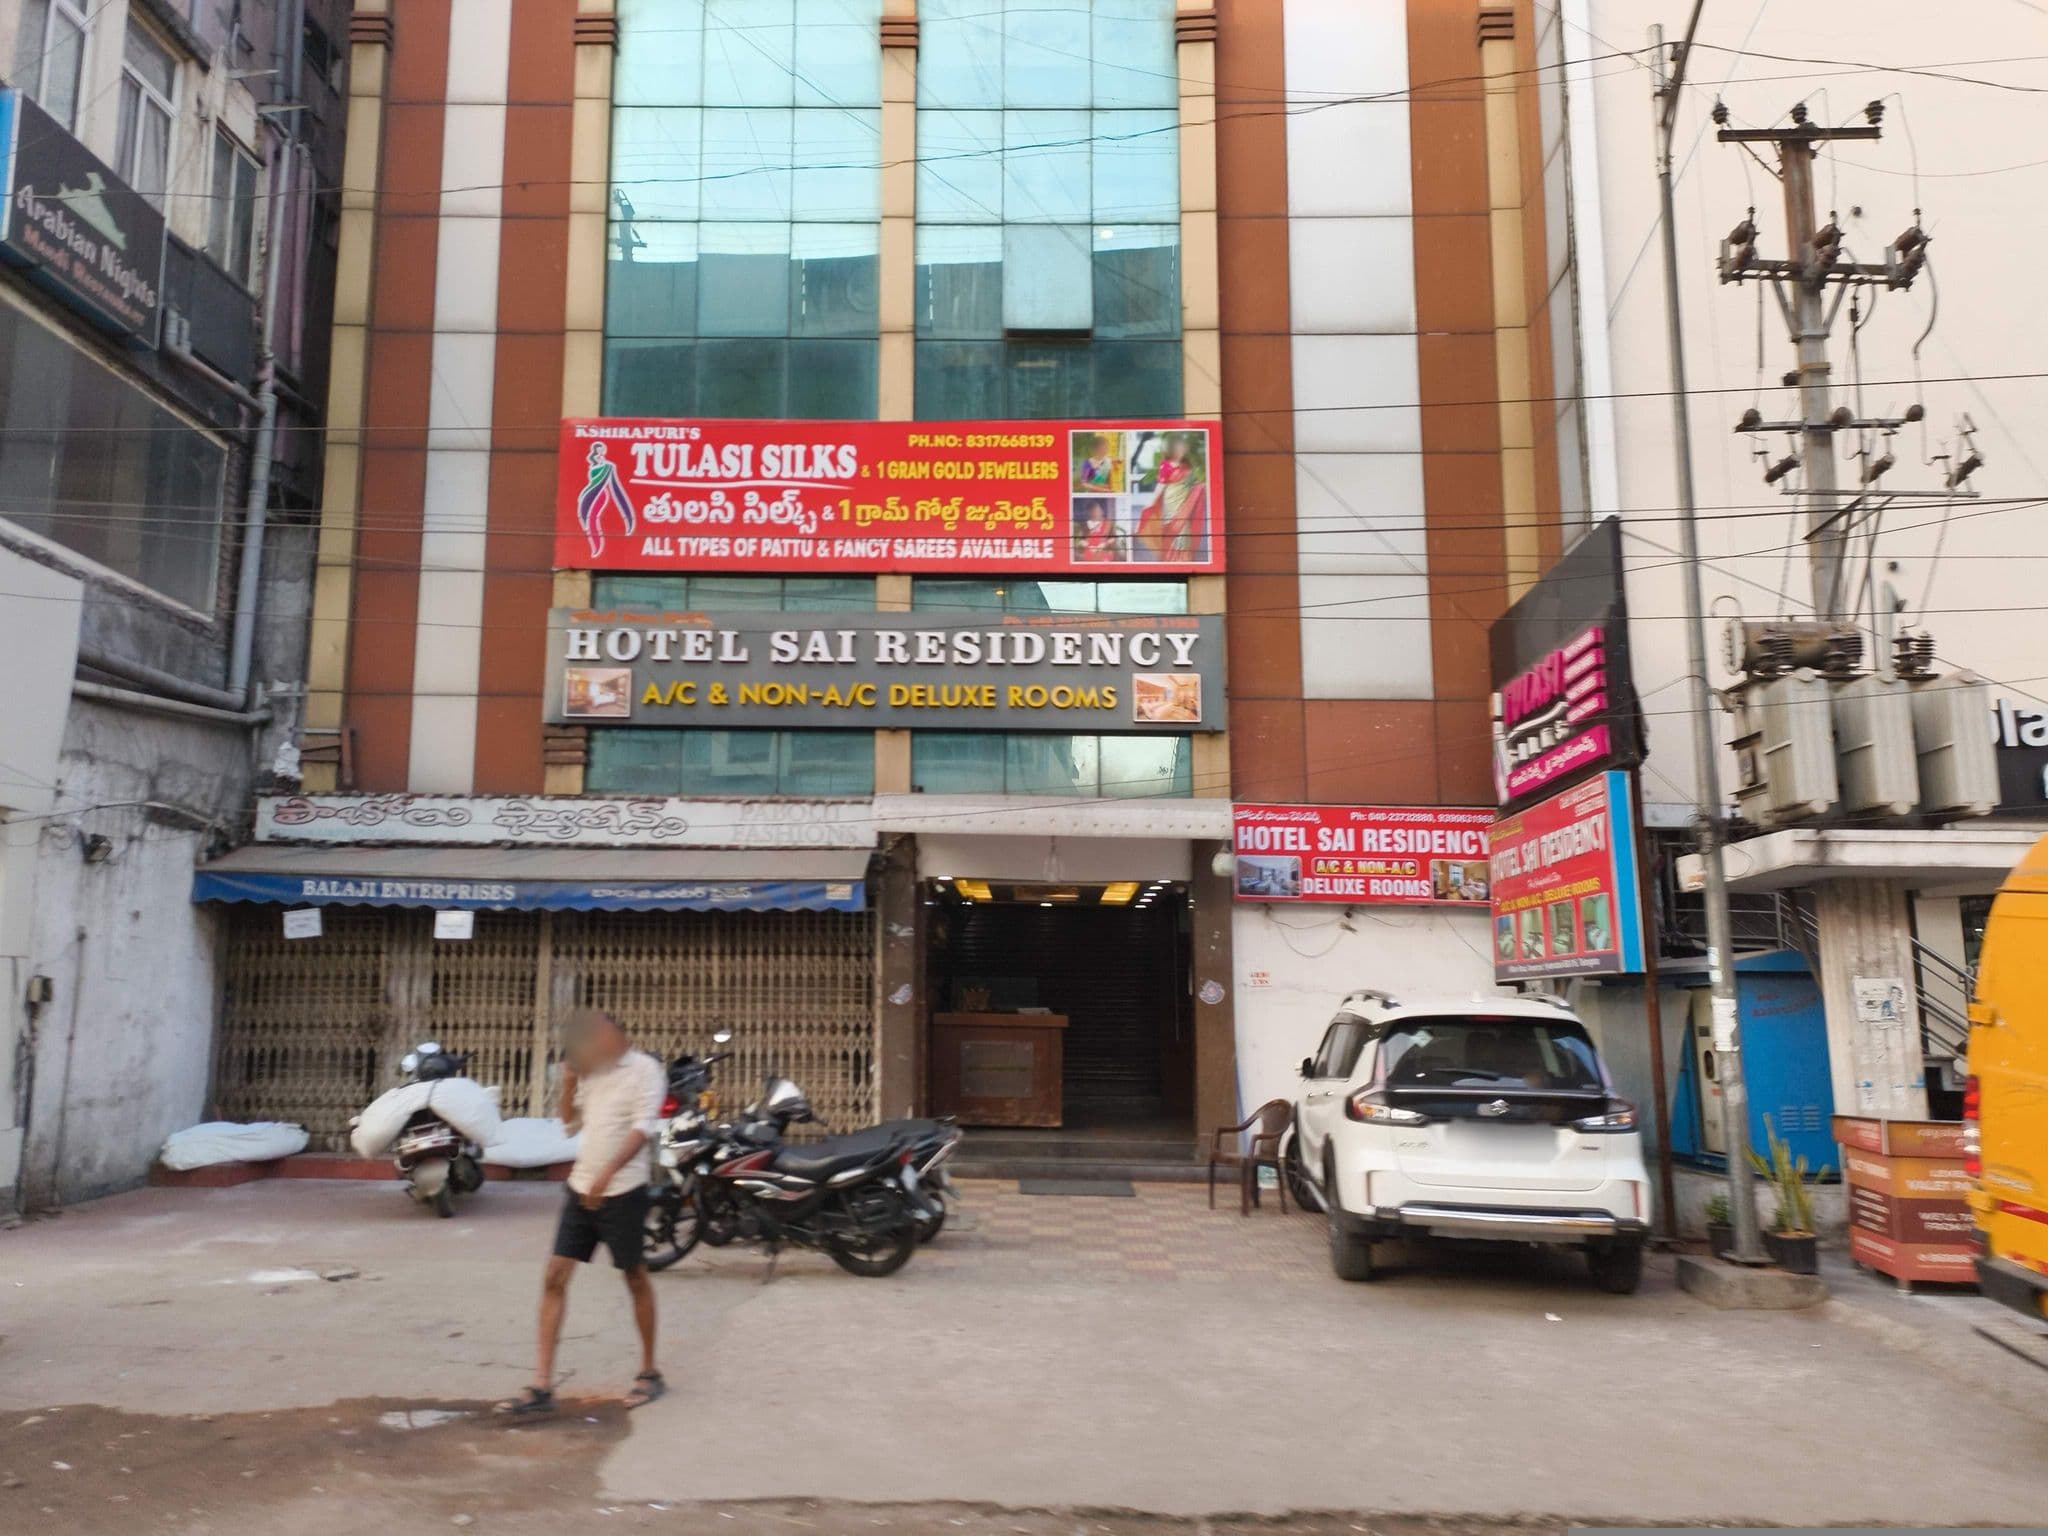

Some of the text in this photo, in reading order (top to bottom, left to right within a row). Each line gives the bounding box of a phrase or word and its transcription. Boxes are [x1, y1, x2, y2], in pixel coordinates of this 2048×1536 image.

[16, 184, 157, 309] Arabian Nights
[908, 434, 1055, 448] PH.NO: 8317668139
[630, 442, 1059, 480] TULASI SILKS & 1 GRAM GOLD JEWELLERS
[642, 492, 735, 524] తులసి
[821, 505, 835, 521] &
[839, 500, 851, 521] 1
[855, 497, 910, 527] గ్రామ్
[915, 497, 964, 531] గోల్డ్
[641, 537, 1054, 559] ALL TYPES OF PATTU & FANCY SAREES AVAILABLE
[565, 628, 1200, 666] HOTEL SAI RESIDENCY
[641, 681, 1119, 709] A/C & NON-A/C DELUXE ROOMS
[733, 824, 861, 846] FASHIONS
[1238, 826, 1312, 850] HOTEL
[1317, 827, 1356, 851] SAI
[1362, 829, 1491, 855] RESIDENCY
[1316, 860, 1416, 875] A/C & NON-A/C
[303, 880, 516, 901] BALAJI ENTERPRISES
[1303, 877, 1431, 897] DELUXE ROOMS
